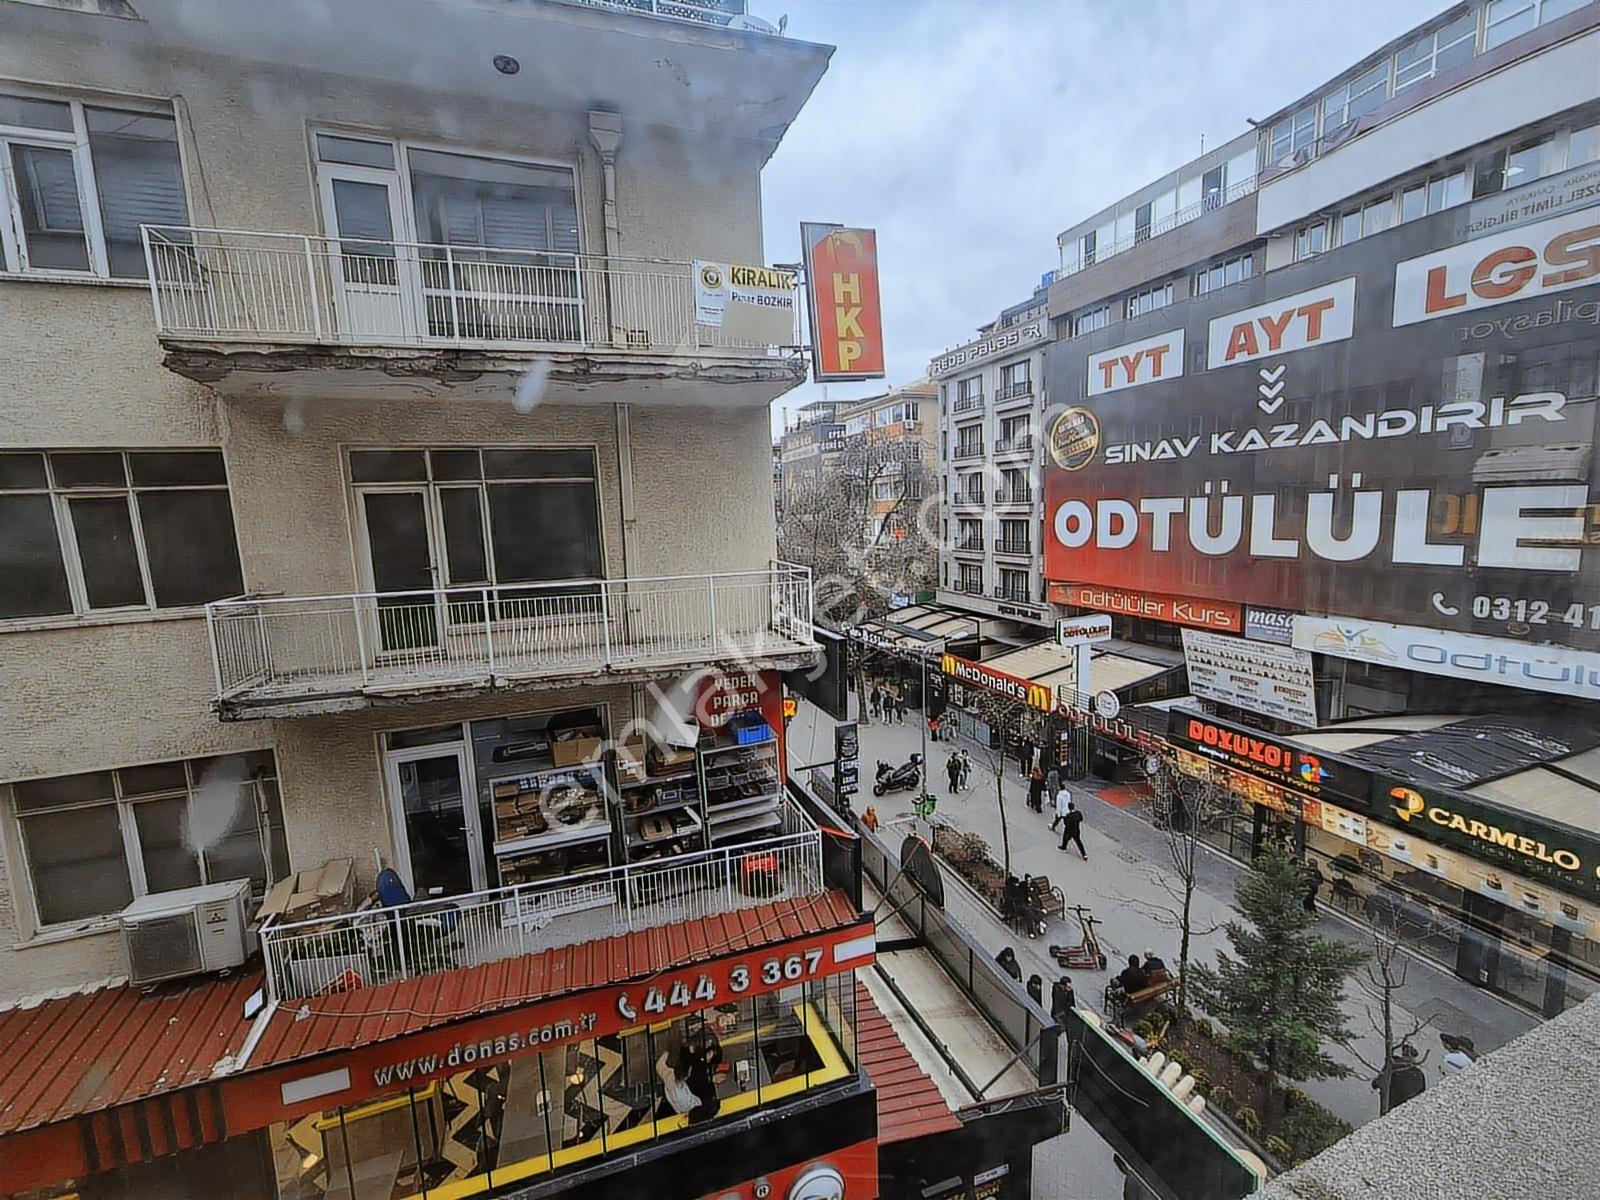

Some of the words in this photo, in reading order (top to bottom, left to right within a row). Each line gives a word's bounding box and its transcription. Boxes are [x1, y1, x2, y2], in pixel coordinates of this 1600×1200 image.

[1426, 224, 1600, 314] LGS
[832, 272, 867, 372] HKP
[1225, 298, 1336, 361] AYT
[1098, 344, 1170, 390] TYT
[1104, 435, 1200, 466] SINAV
[1210, 391, 1567, 455] KAZANDIRIR
[1054, 472, 1589, 571] ODTÜLÜLE
[1079, 589, 1166, 617] Odtülüler
[1172, 602, 1232, 627] Kurs
[1472, 596, 1549, 625] 0312
[955, 662, 1026, 698] McDonald's
[1428, 807, 1580, 871] CARMELO
[644, 976, 717, 1014] 444
[730, 968, 751, 993] 3
[763, 950, 825, 986] 367
[374, 1012, 598, 1086] www.donas.com.tr
